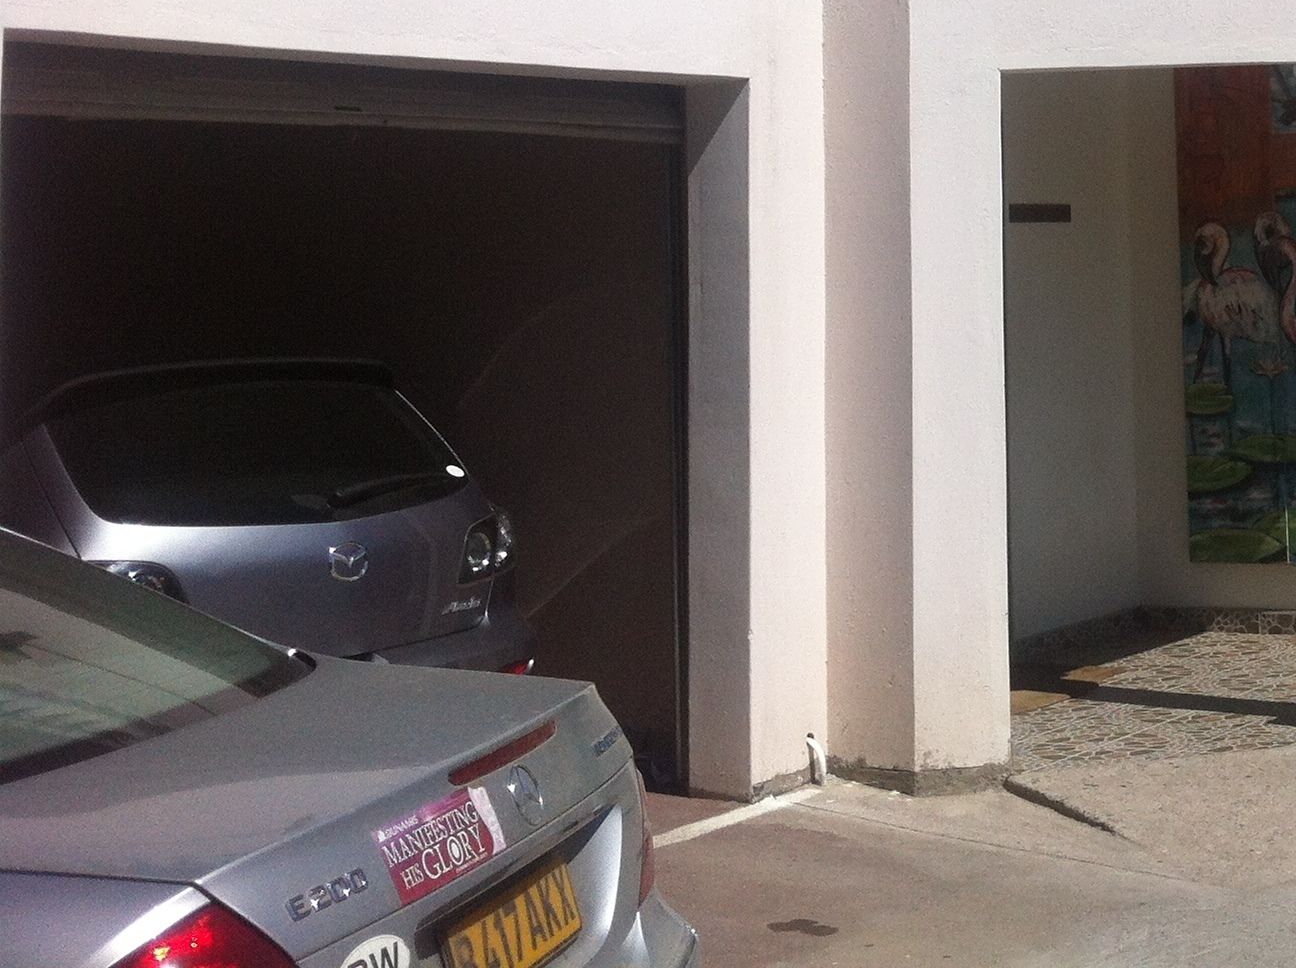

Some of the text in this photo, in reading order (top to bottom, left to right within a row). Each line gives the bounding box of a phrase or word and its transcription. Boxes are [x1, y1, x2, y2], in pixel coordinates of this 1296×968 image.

[381, 801, 479, 868] MANIFESTING
[401, 862, 425, 890] HIS
[422, 823, 486, 880] GLORY
[285, 868, 369, 922] E200
